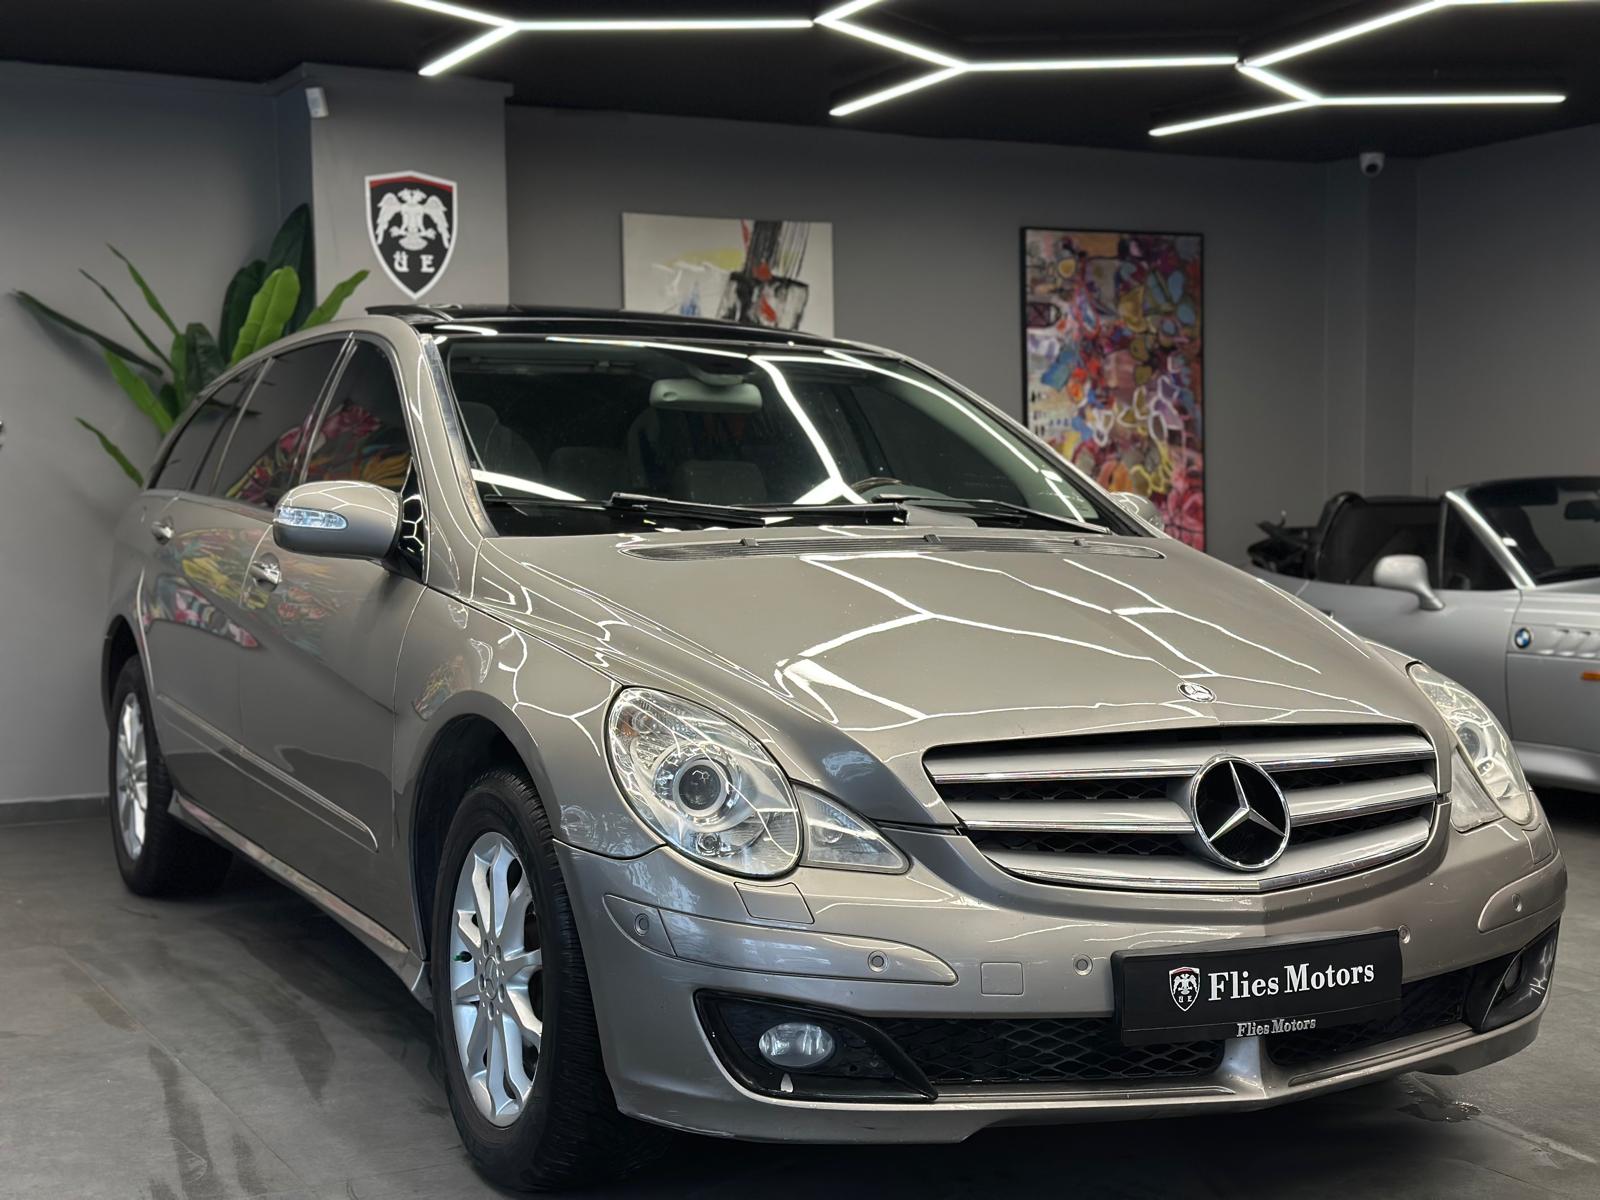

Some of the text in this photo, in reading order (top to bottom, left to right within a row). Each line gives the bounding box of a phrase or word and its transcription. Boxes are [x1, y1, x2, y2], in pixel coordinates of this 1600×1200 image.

[1208, 963, 1375, 1001] Flies Motors
[1236, 1017, 1316, 1037] Flies Motors
